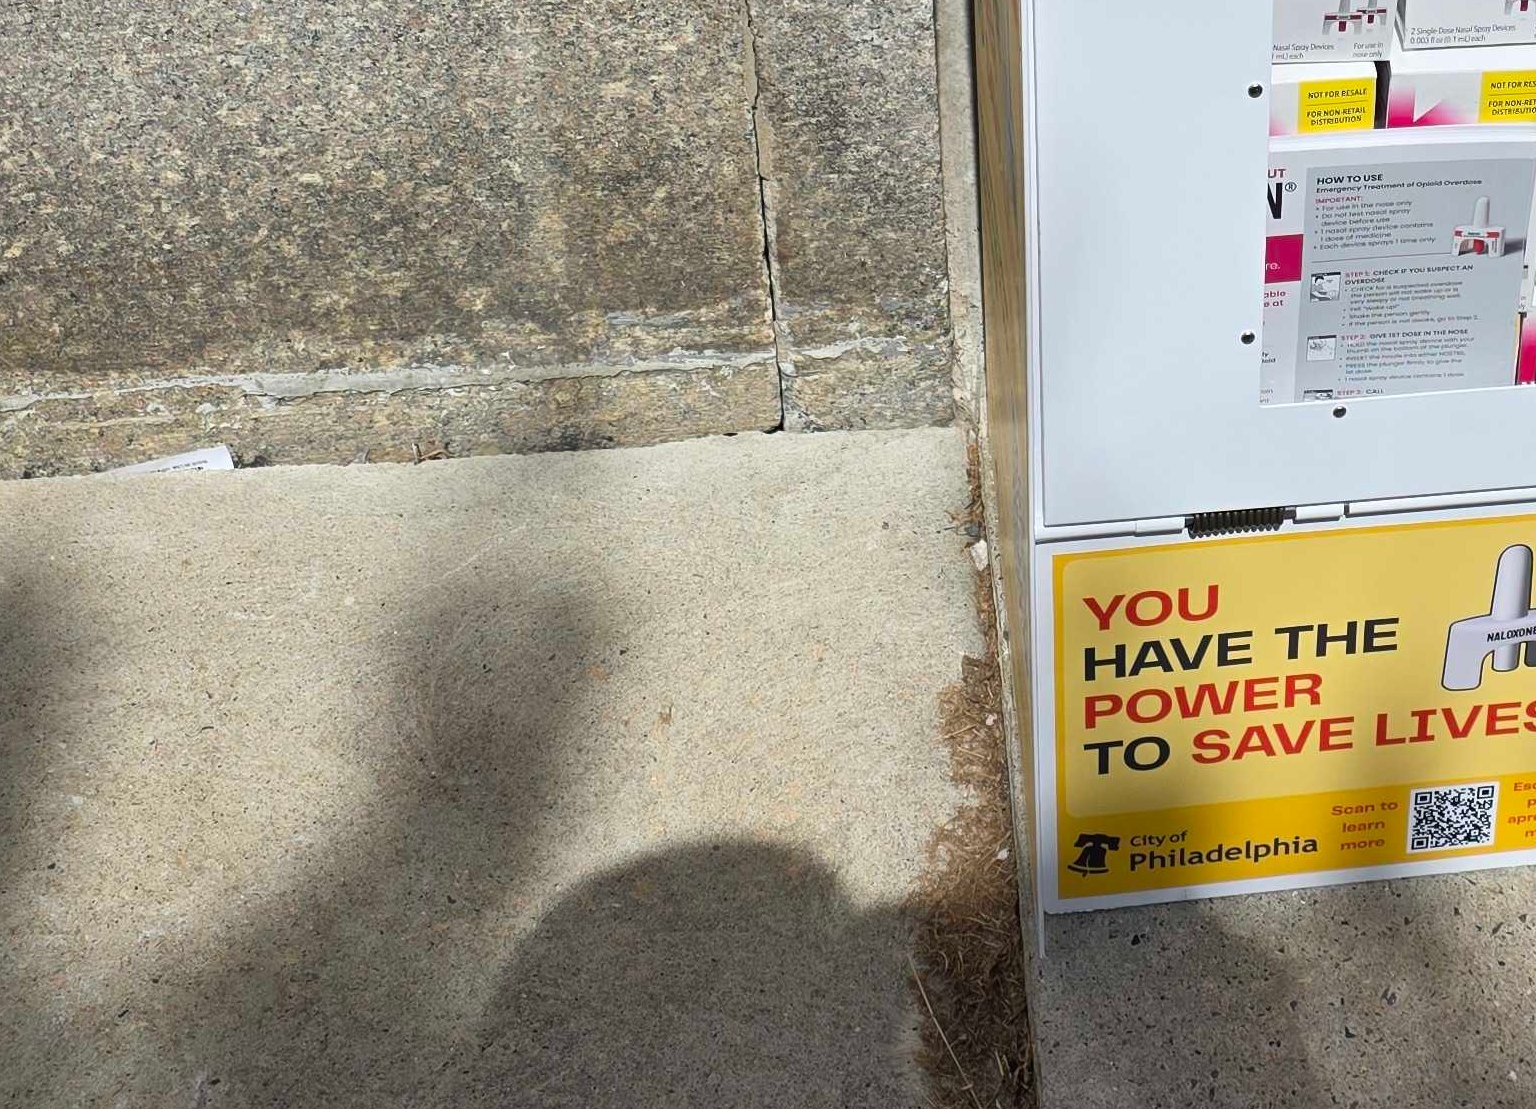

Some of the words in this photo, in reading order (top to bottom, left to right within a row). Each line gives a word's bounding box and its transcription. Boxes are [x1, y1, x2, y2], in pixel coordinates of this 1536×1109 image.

[1490, 81, 1506, 89] NOT
[1508, 80, 1522, 88] FOR
[1308, 91, 1322, 99] NOT
[1341, 88, 1367, 97] RESALE
[1307, 110, 1321, 118] FOR
[1323, 107, 1366, 117] NON-RETAIL
[1311, 116, 1362, 126] DISTRIBUTION
[1316, 176, 1345, 185] HOW
[1363, 174, 1383, 182] USE
[1316, 186, 1361, 194] Emergency
[1417, 180, 1442, 188] Opioid
[1315, 196, 1363, 204] IMPORTANT:
[1082, 584, 1219, 631] YOU
[1084, 630, 1253, 681] HAVE
[1274, 617, 1399, 660] THE
[1084, 673, 1323, 730] POWER
[1084, 736, 1170, 775] TO
[1192, 716, 1355, 764] SAVE
[1331, 803, 1375, 816] Scan
[1380, 800, 1398, 811] to
[1342, 819, 1386, 833] learn
[1130, 834, 1166, 849] City
[1169, 830, 1188, 844] of
[1340, 838, 1386, 851] more
[1129, 836, 1318, 872] Philadelphia
